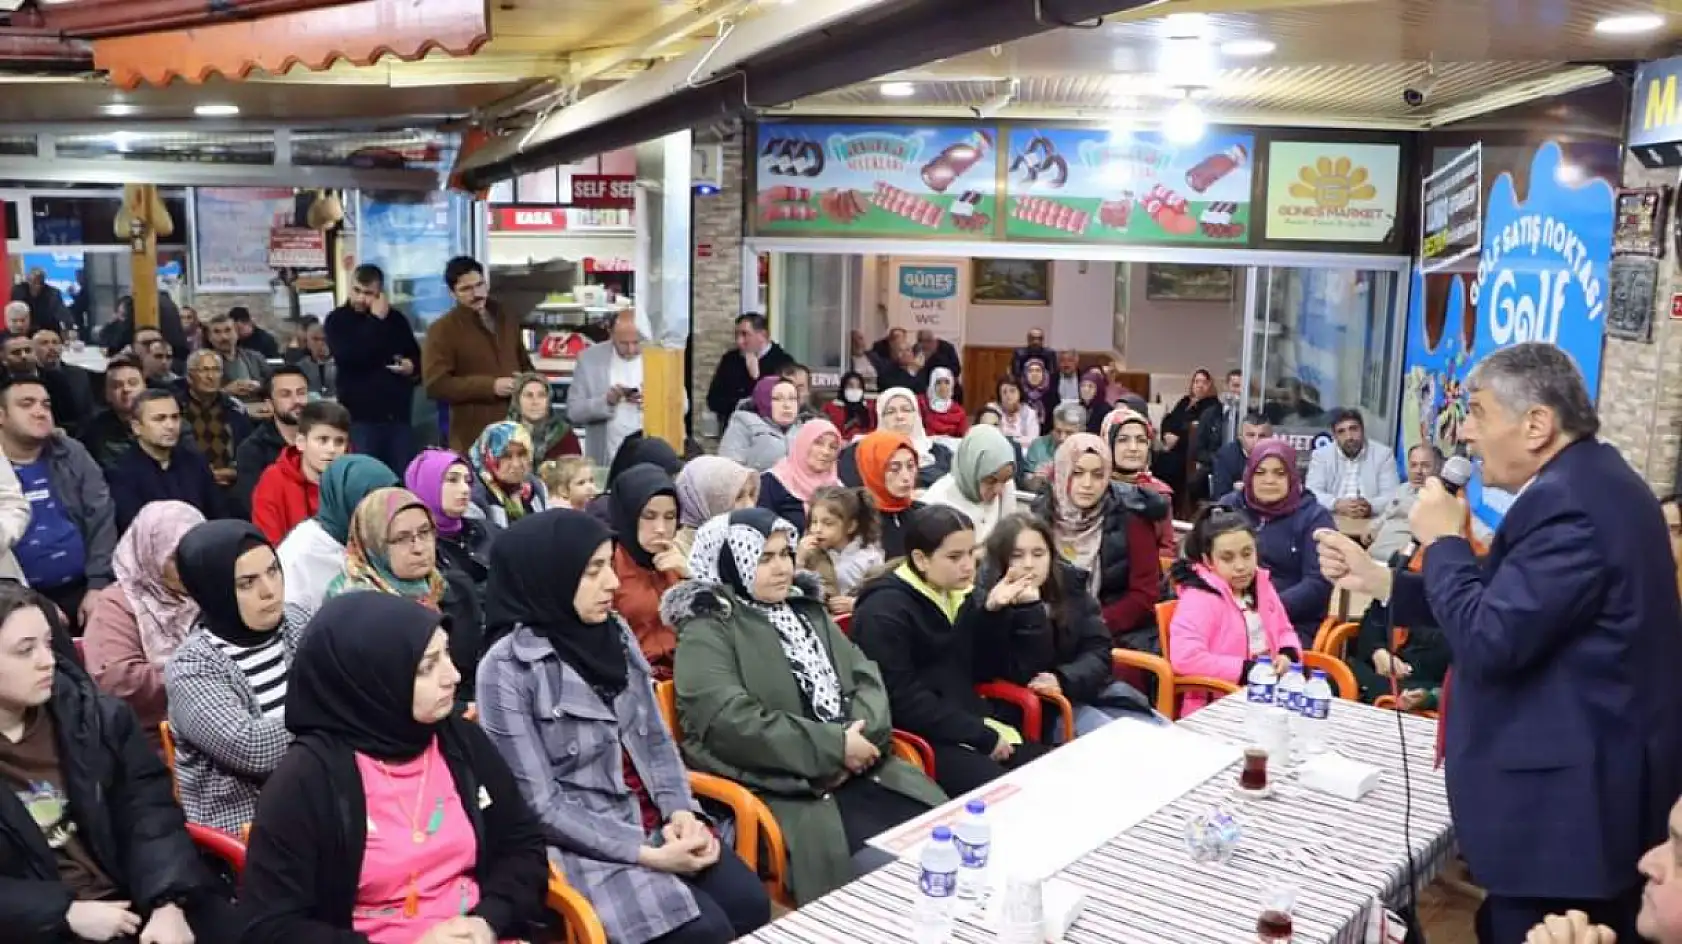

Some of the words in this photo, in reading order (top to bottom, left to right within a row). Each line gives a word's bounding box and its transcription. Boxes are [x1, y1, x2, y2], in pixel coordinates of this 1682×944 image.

[573, 179, 606, 198] SELF
[514, 211, 554, 225] KASA
[1325, 206, 1384, 219] MARKET
[1469, 234, 1501, 306] GOLF
[1502, 214, 1541, 255] SATIŞ
[904, 270, 954, 292] GÜNEŞ
[1490, 268, 1571, 344] Golf
[915, 313, 941, 325] WC
[811, 372, 841, 386] ERYA
